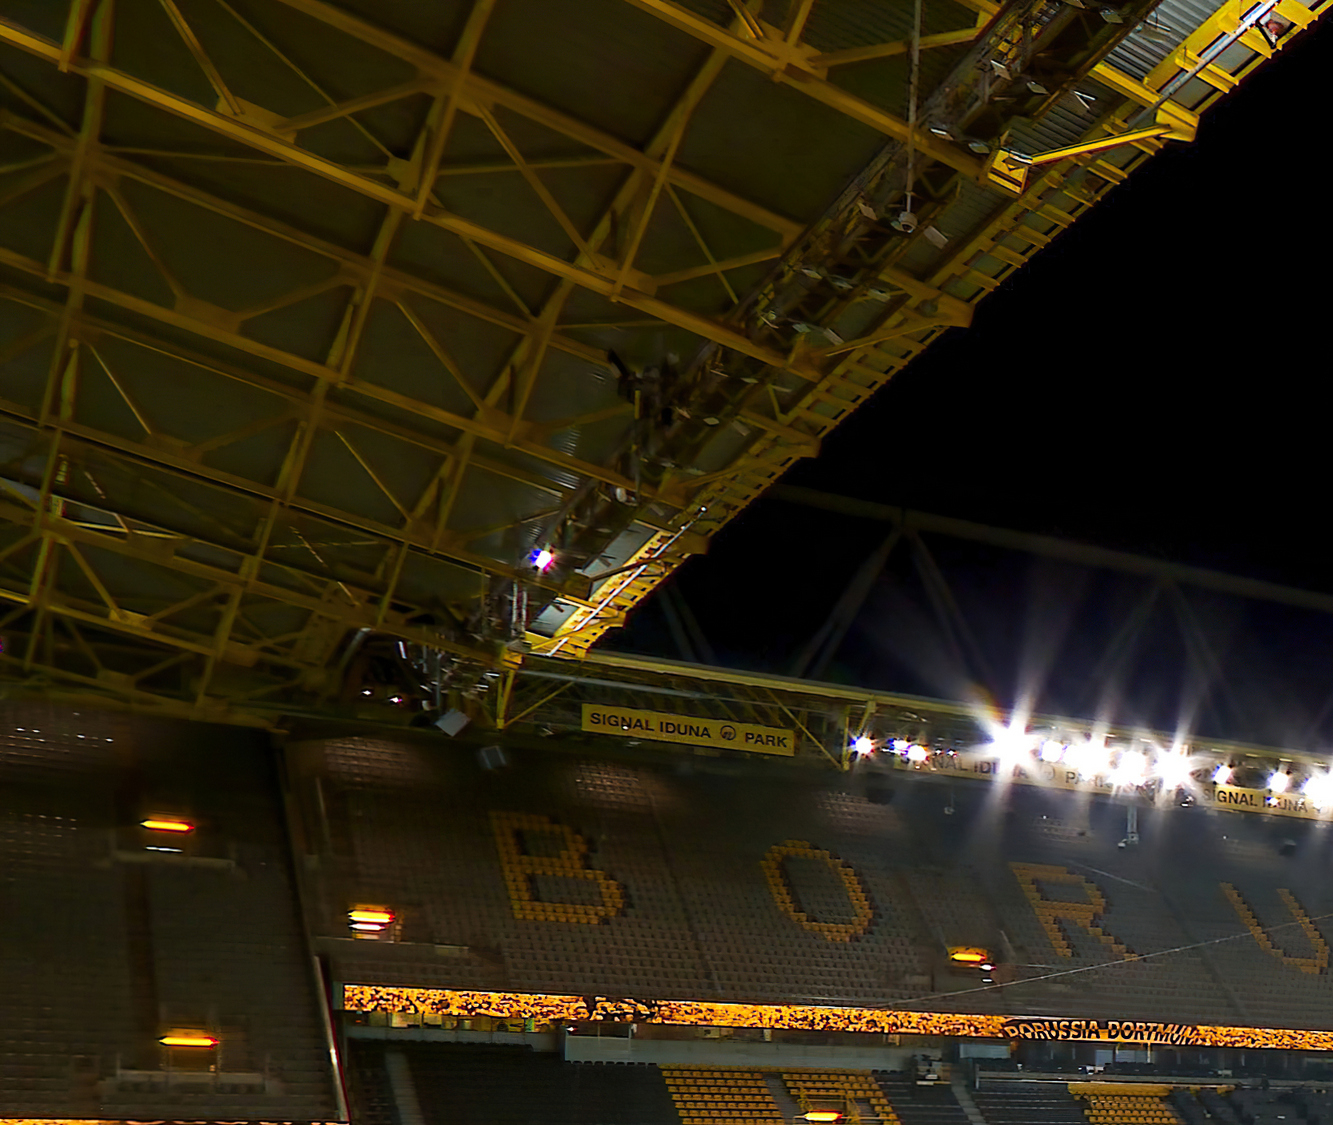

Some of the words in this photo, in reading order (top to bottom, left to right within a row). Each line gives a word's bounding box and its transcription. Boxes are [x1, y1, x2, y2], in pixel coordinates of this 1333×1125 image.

[590, 712, 655, 731] SIGNAL
[659, 721, 711, 739] IDUNA
[745, 732, 788, 749] PARK
[1262, 796, 1308, 813] IUNA
